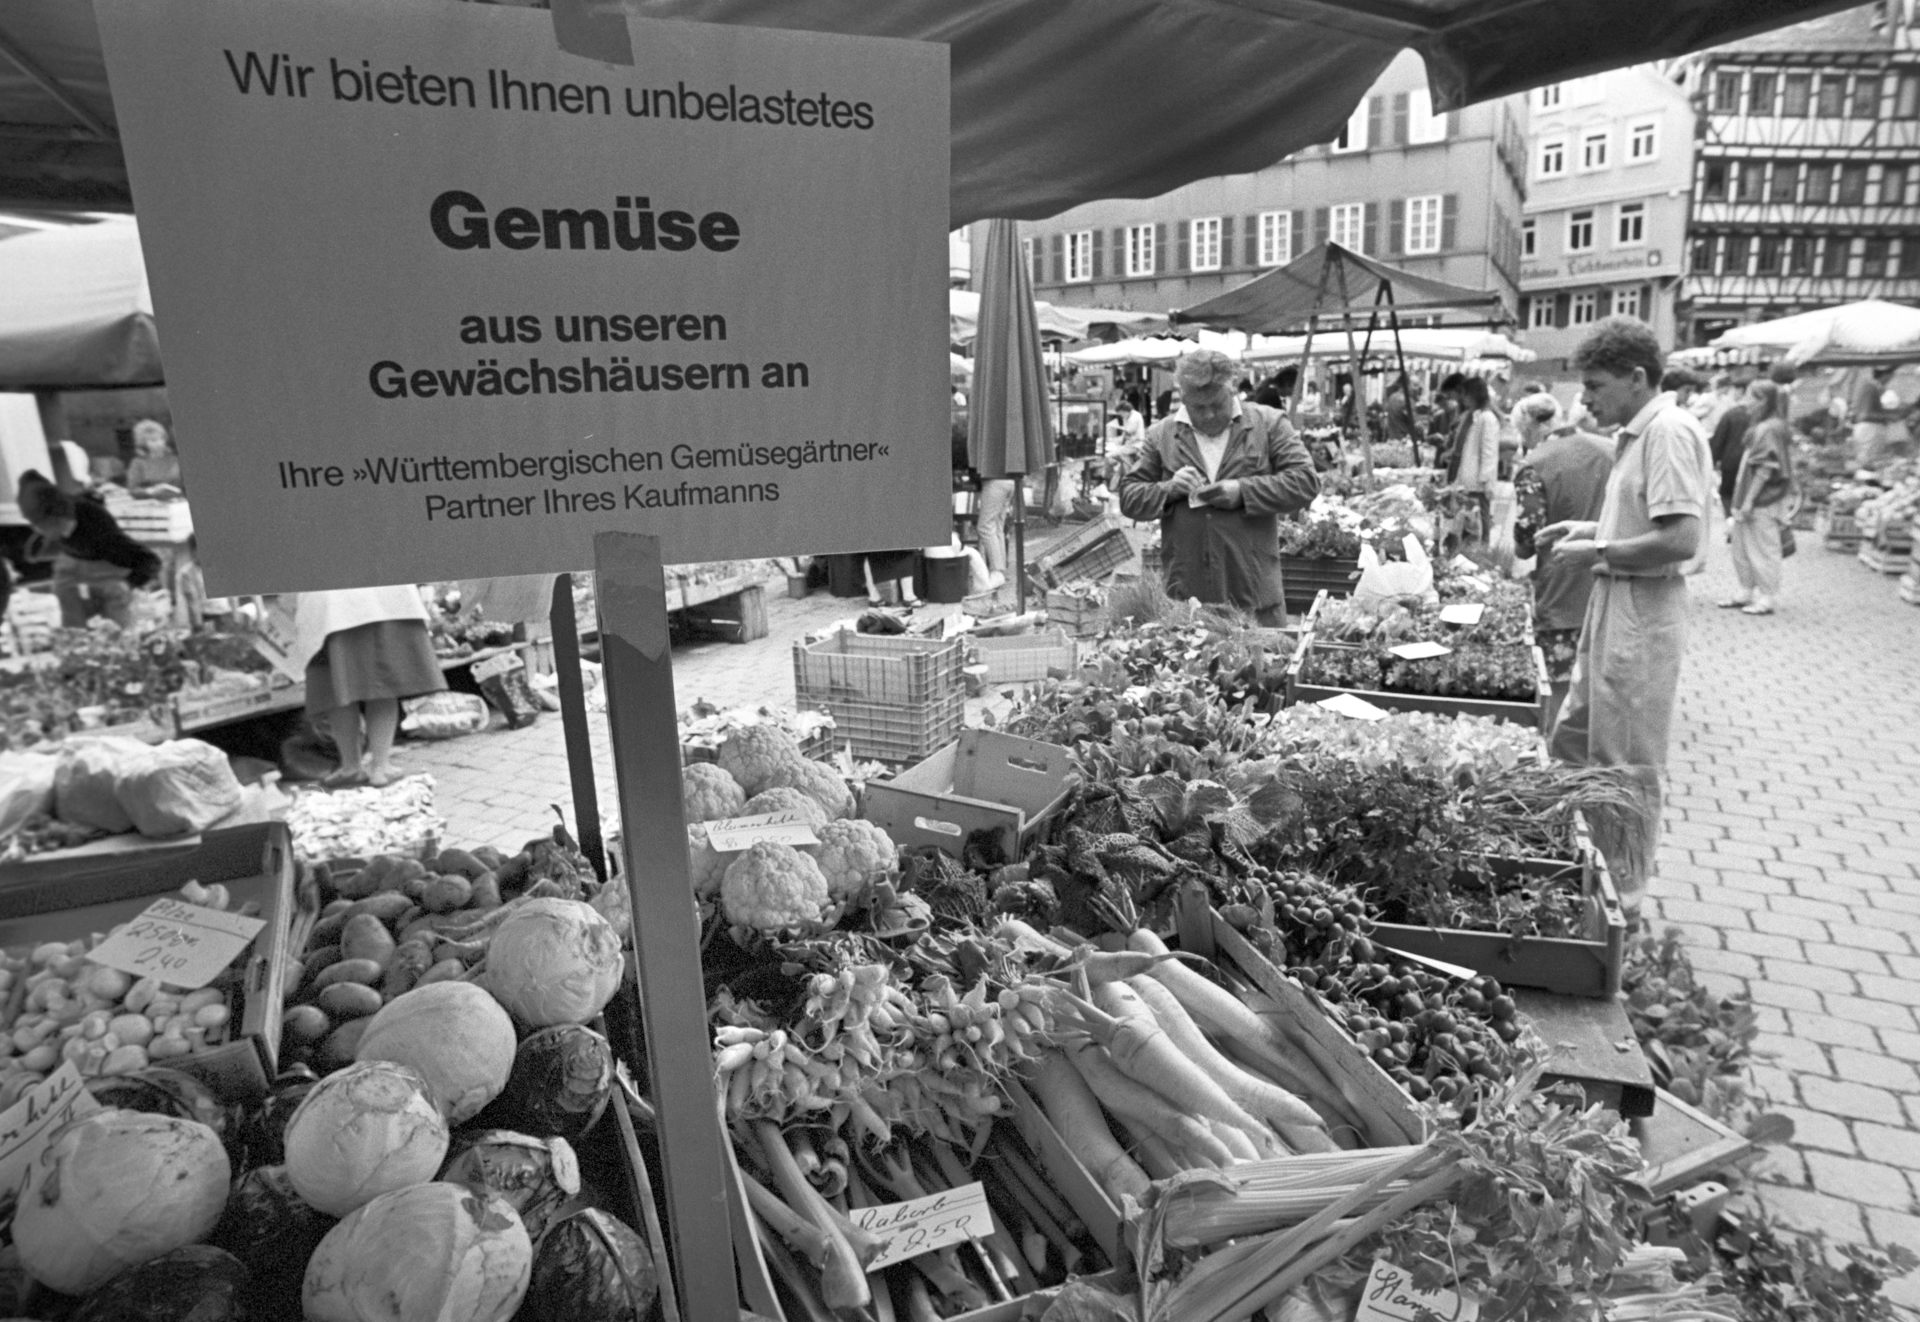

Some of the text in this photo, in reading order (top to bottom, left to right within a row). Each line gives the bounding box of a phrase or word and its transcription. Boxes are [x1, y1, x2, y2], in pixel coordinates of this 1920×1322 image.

[222, 48, 875, 131] Wir bieten Ihnen unbelastetes
[429, 189, 741, 253] Gemüse
[459, 313, 727, 345] aus unseren
[368, 356, 810, 400] Gewächshäusern an
[278, 460, 345, 489] Ihre
[425, 480, 780, 522] Partner Ihres Kaufmanns
